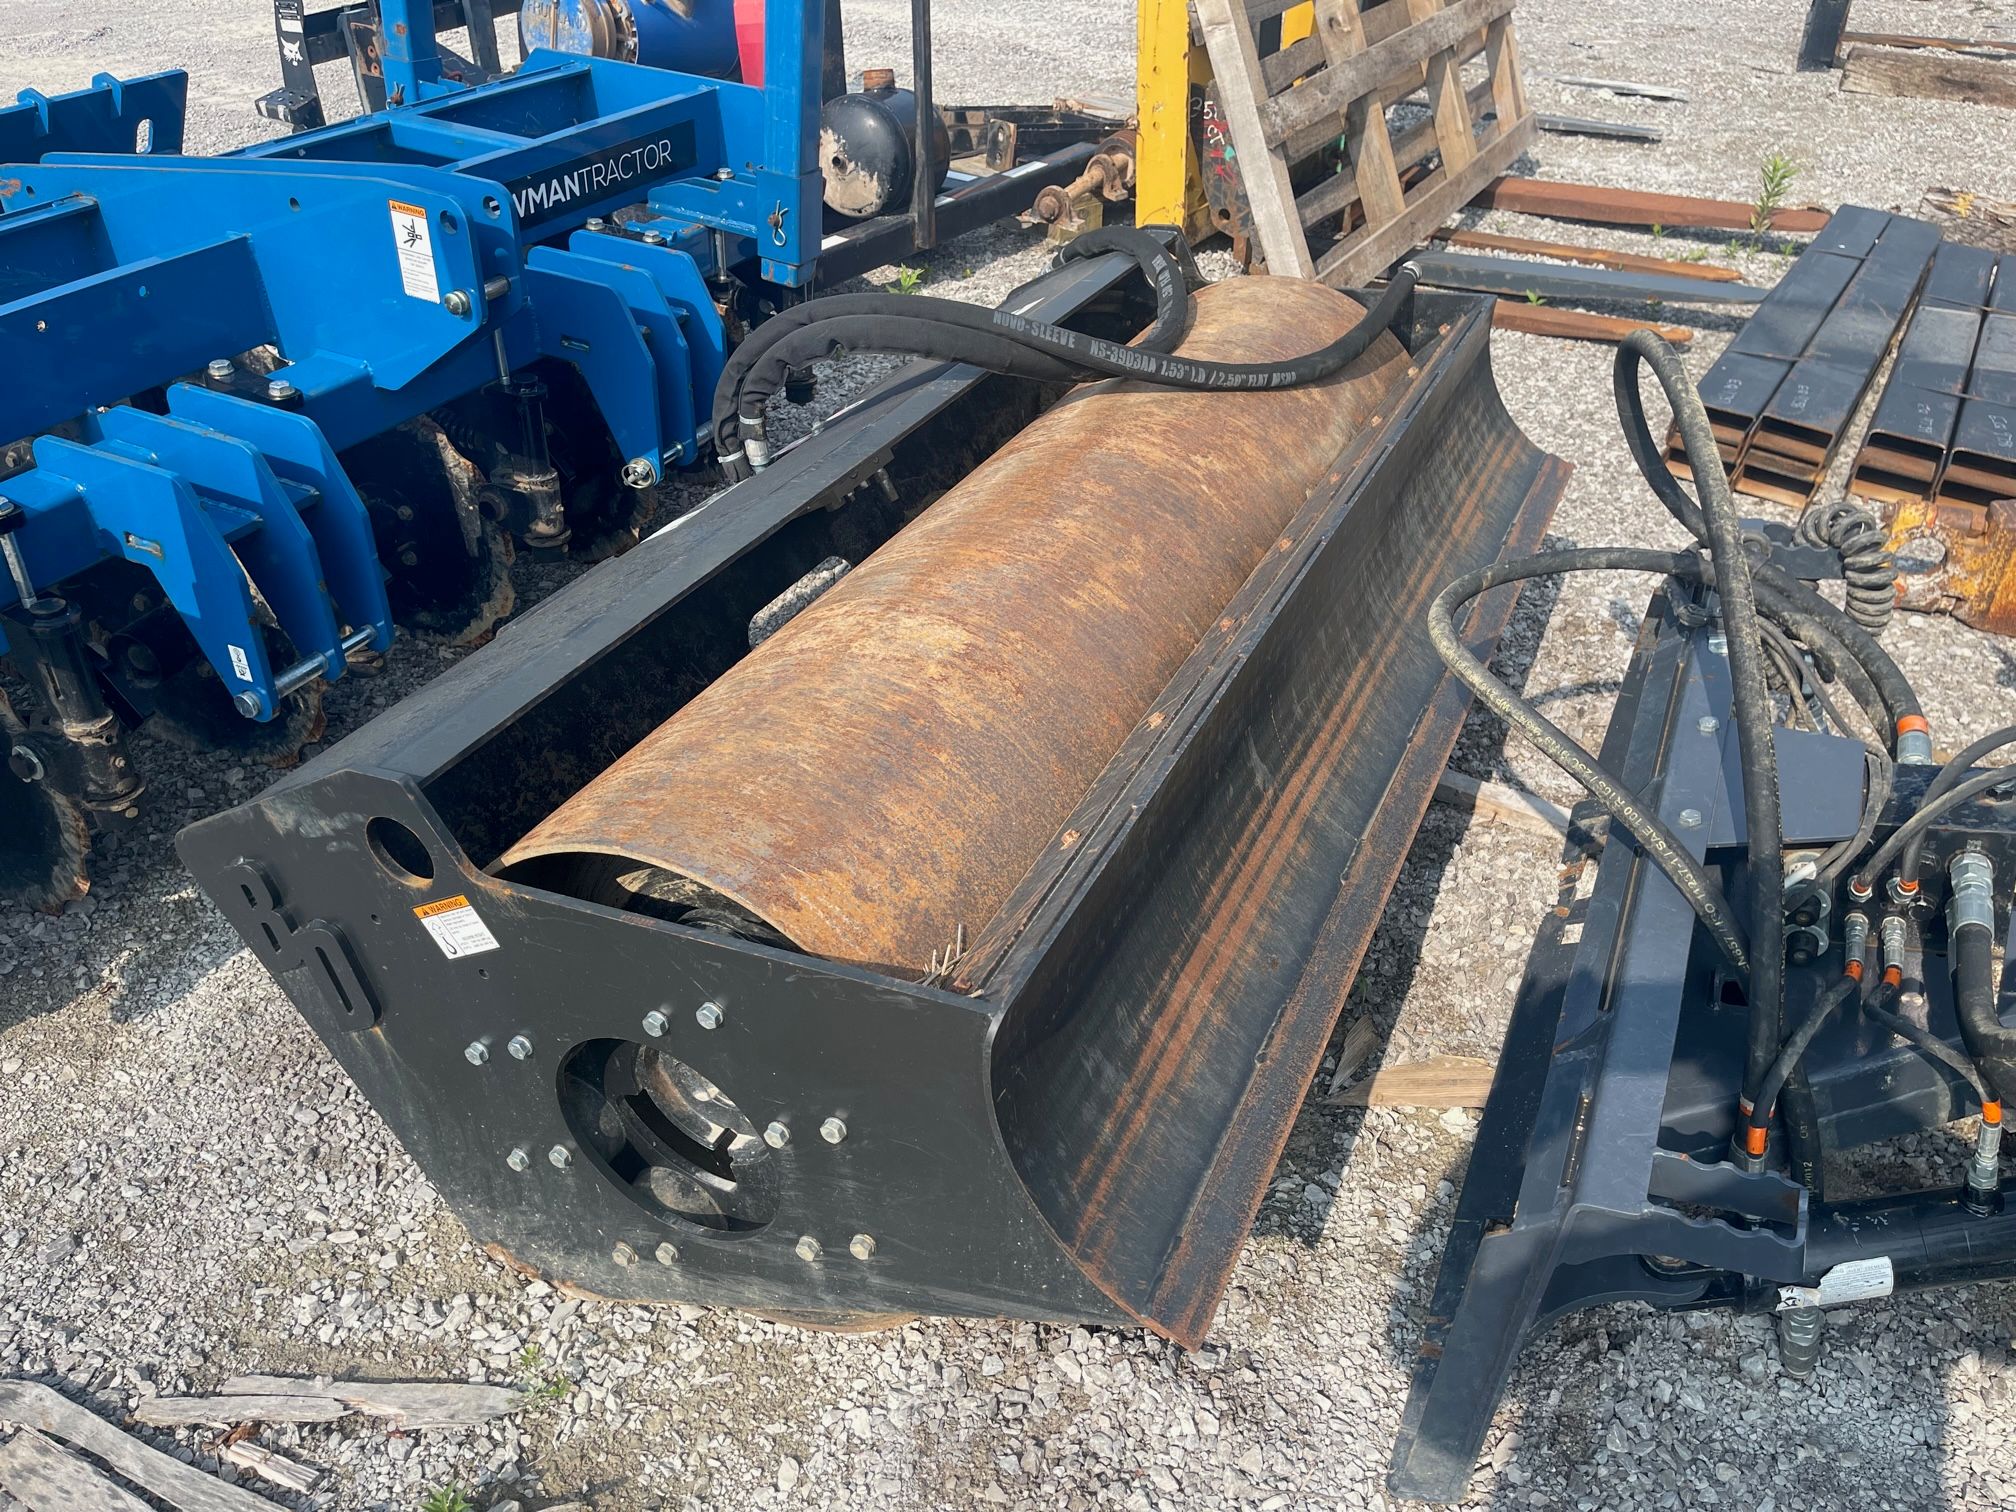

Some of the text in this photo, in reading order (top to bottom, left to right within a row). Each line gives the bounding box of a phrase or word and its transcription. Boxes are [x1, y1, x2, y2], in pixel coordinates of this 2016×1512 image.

[397, 204, 425, 217] WARNING
[993, 311, 1077, 348] NUVO-SLEEVE
[1643, 825, 1667, 851] SAE
[428, 898, 462, 914] WARNING
